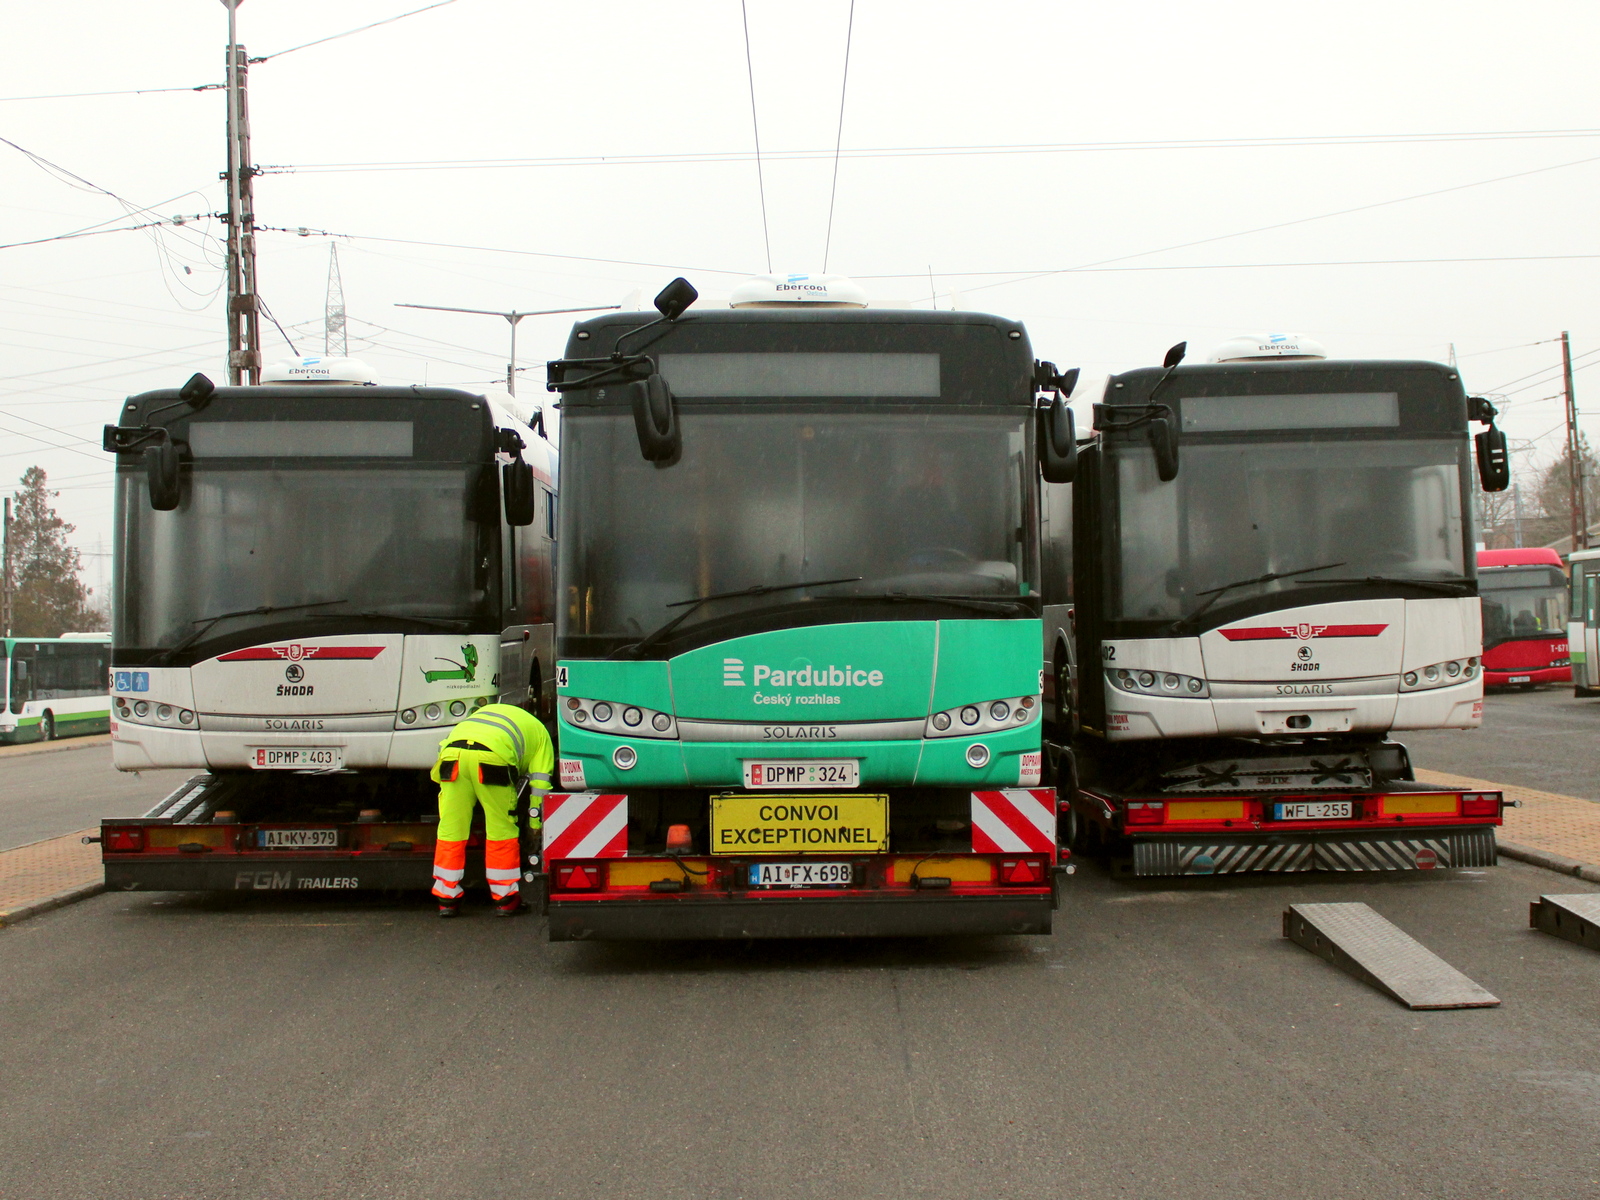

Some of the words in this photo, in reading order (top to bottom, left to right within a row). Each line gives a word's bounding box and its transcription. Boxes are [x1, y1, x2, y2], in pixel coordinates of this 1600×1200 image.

[776, 283, 828, 292] Ebercool
[1291, 662, 1320, 671] ŠKODA
[754, 665, 884, 687] Pardubice
[276, 684, 314, 696] ŠKODA
[1276, 685, 1333, 695] SOLARIS
[753, 691, 792, 706] Český
[795, 694, 841, 705] rozhlas
[265, 720, 324, 730] SOLARIS
[763, 727, 837, 739] SOLARIS
[268, 751, 299, 764] DPMP
[310, 751, 332, 763] 403
[767, 767, 806, 782] DPMP
[818, 766, 847, 782] 324
[759, 805, 839, 821] CONVOI
[1285, 803, 1349, 818] WFL-255
[267, 832, 283, 845] AI
[721, 828, 878, 844] EXCEPTIONNEL
[235, 871, 292, 890] FGM
[297, 877, 359, 889] TRAILERS
[762, 866, 782, 882] AI
[791, 865, 849, 882] FX-698
